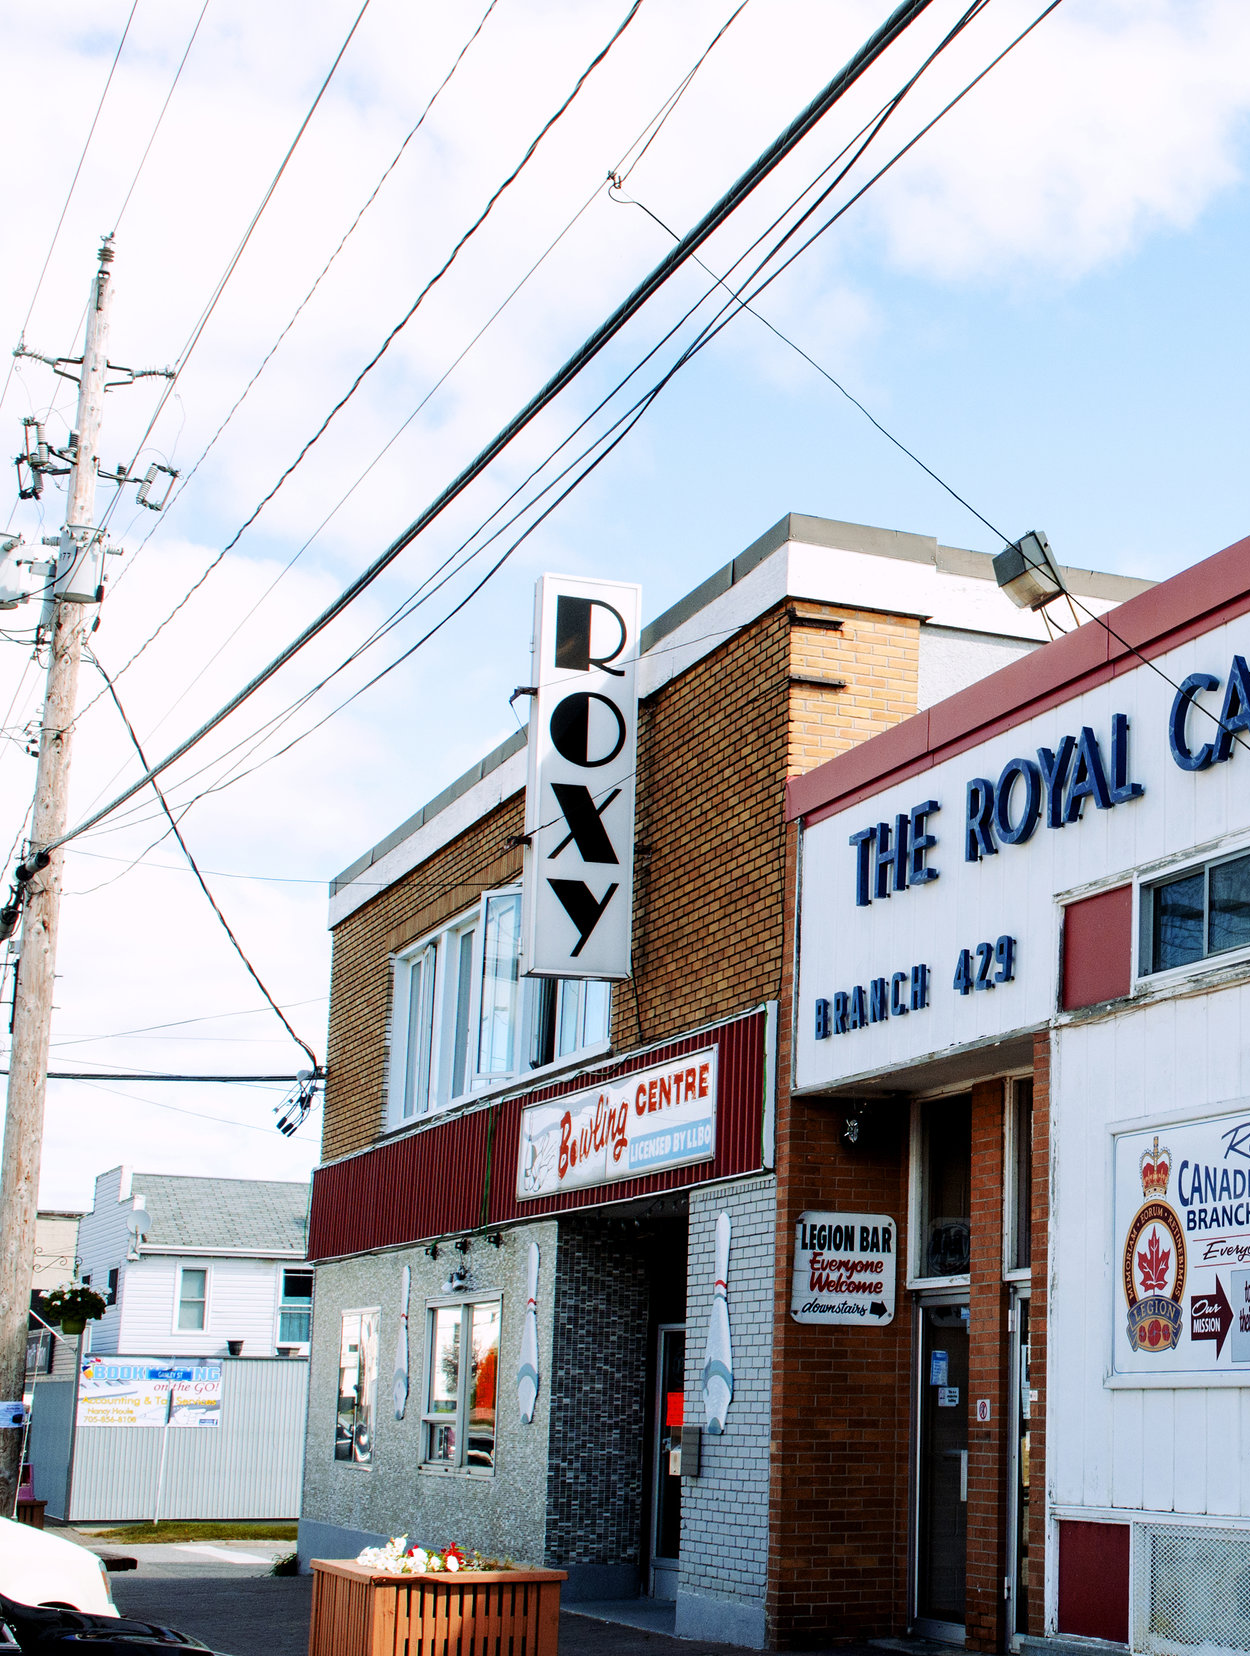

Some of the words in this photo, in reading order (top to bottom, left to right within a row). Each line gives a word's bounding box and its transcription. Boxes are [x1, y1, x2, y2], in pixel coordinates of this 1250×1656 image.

[547, 594, 627, 957] ROXY
[849, 800, 941, 906] THE
[965, 713, 1144, 862] ROYAL
[815, 963, 930, 1040] BRANCH
[953, 935, 1016, 996] 429
[558, 1094, 629, 1180] Bowling
[635, 1062, 710, 1116] CENTRE
[630, 1135, 672, 1164] LICENSED
[672, 1130, 687, 1153] BY
[687, 1124, 711, 1149] LLBO
[801, 1224, 855, 1251] LEGION
[860, 1226, 892, 1253] BAR
[1125, 1231, 1138, 1300] MEMORIAM
[1139, 1206, 1164, 1222] EORUM
[809, 1251, 884, 1280] Everyone
[809, 1271, 884, 1294] Welcome
[1245, 1280, 1250, 1302] to
[801, 1297, 868, 1316] downstairs
[1133, 1300, 1176, 1320] LEGION
[1192, 1299, 1221, 1317] Our
[1193, 1318, 1221, 1333] MISSION
[94, 1365, 220, 1380] BOOKNG
[173, 1381, 191, 1391] the
[194, 1382, 219, 1395] GO!
[81, 1396, 140, 1407] Accounting
[144, 1396, 151, 1405] &
[176, 1396, 217, 1405] Services
